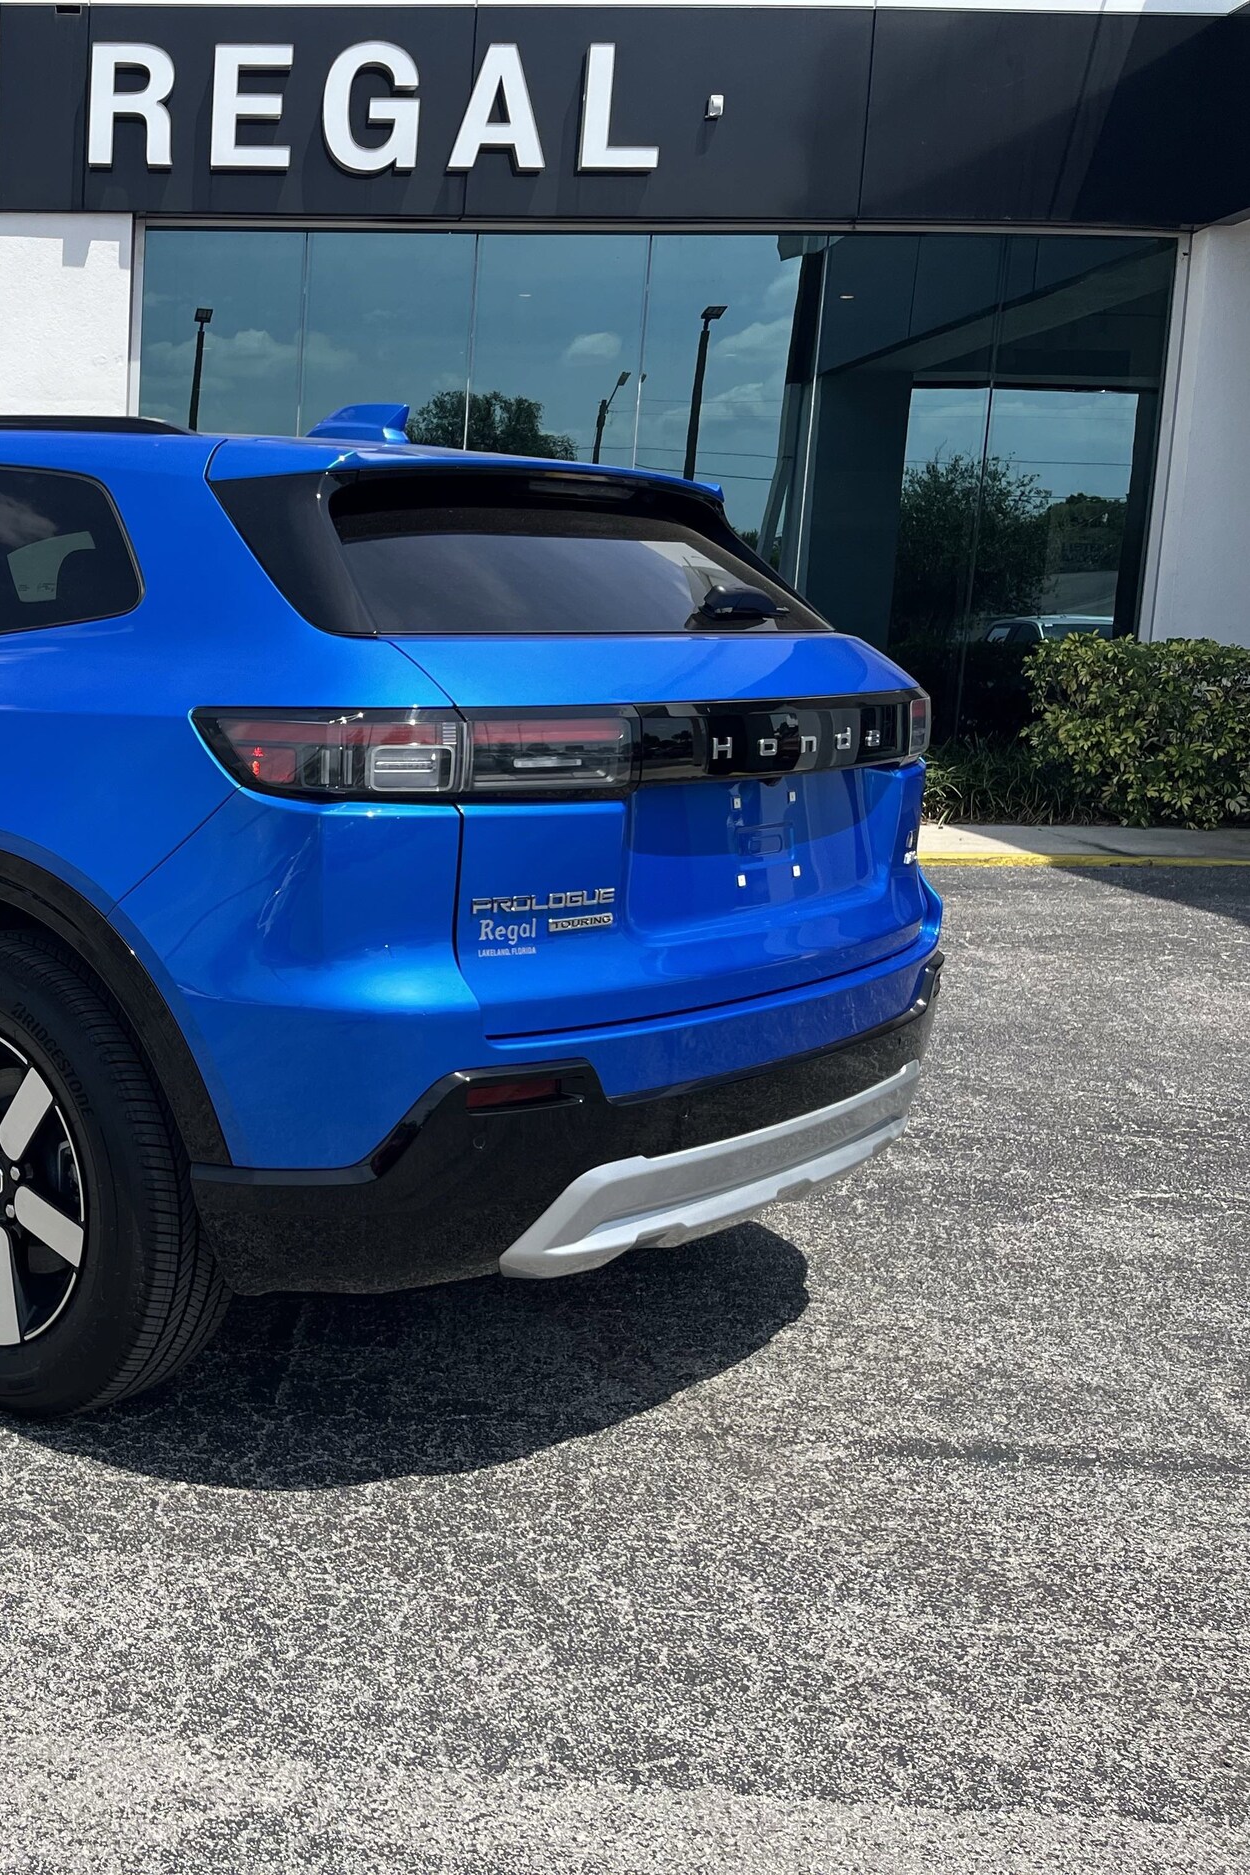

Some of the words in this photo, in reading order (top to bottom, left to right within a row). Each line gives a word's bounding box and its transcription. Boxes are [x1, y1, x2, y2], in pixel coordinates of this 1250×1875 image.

[88, 40, 660, 174] REGAL
[712, 726, 881, 760] Honda
[471, 887, 616, 915] PROLOGUE
[478, 917, 537, 945] Regal
[552, 914, 612, 929] TOURING
[512, 946, 537, 956] FLORIDA
[11, 1001, 94, 1117] BRIDGESTONE
